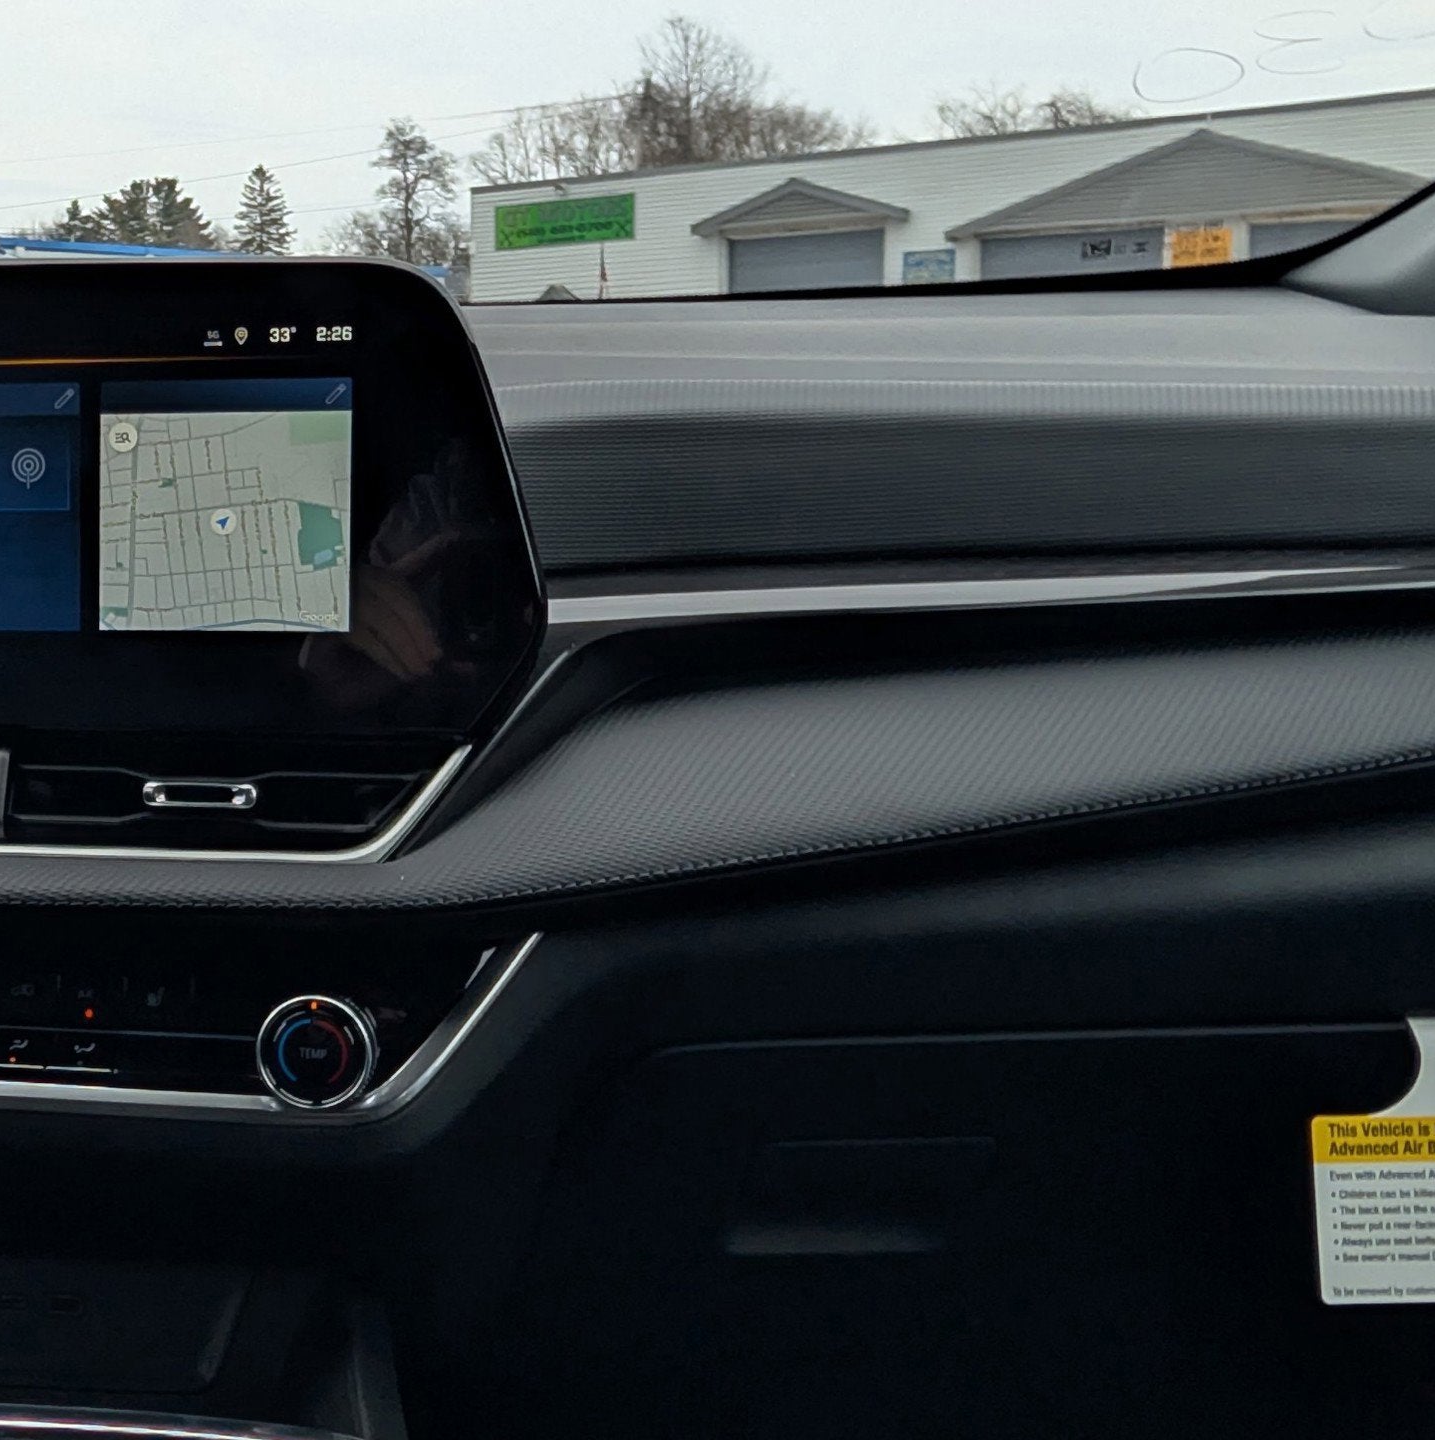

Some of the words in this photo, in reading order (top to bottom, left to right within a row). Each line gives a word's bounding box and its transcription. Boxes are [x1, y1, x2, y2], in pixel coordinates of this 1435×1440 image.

[269, 326, 297, 343] 33°
[316, 326, 353, 342] 2:26
[298, 609, 339, 623] Google
[299, 1047, 328, 1060] TEMP
[1328, 1122, 1358, 1138] This
[1361, 1122, 1414, 1137] Vehicle
[1418, 1122, 1431, 1136] is
[1329, 1140, 1399, 1156] Advanced
[1403, 1140, 1424, 1155] Air
[1330, 1170, 1353, 1181] Even
[1355, 1170, 1376, 1180] with
[1379, 1169, 1426, 1180] Advanced
